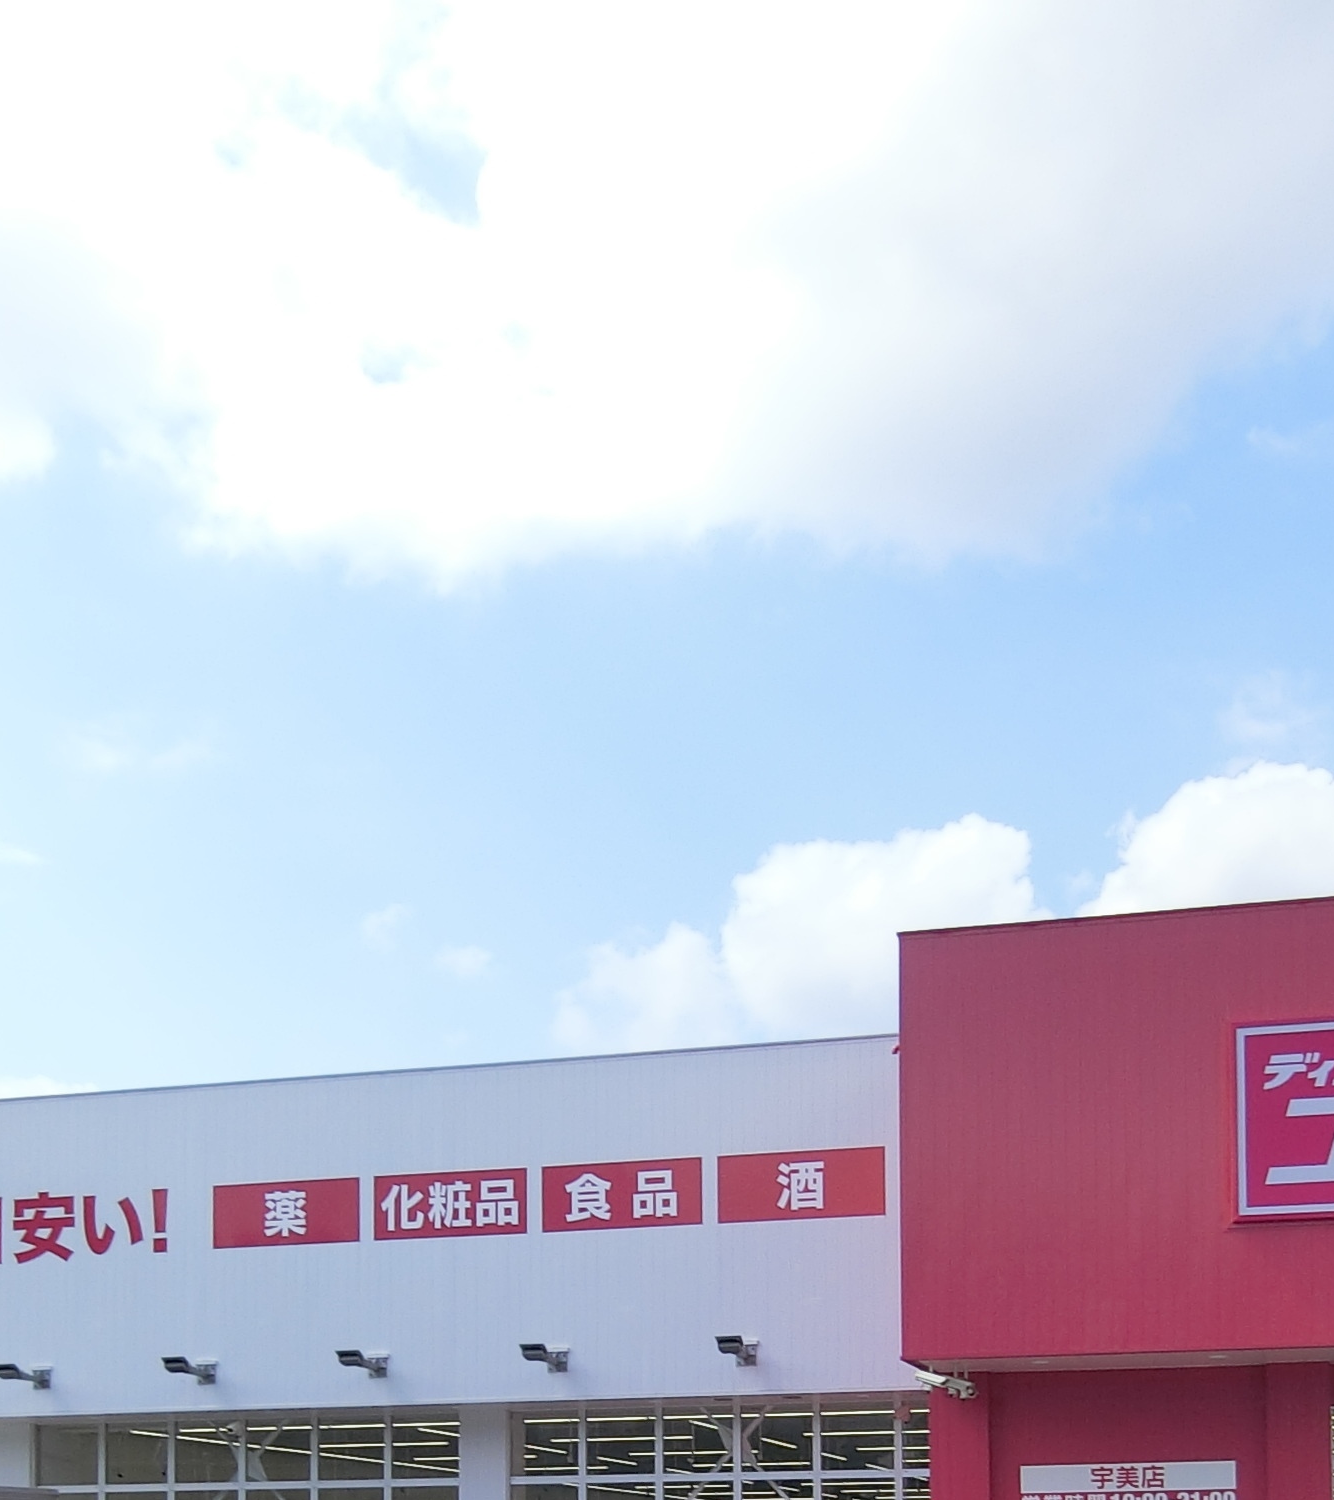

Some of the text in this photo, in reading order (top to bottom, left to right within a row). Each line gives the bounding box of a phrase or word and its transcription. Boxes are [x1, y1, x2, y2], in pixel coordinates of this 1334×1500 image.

[263, 1161, 825, 1238] 薬 化粧品 食品 酒
[1090, 1465, 1166, 1489] 宇美店
